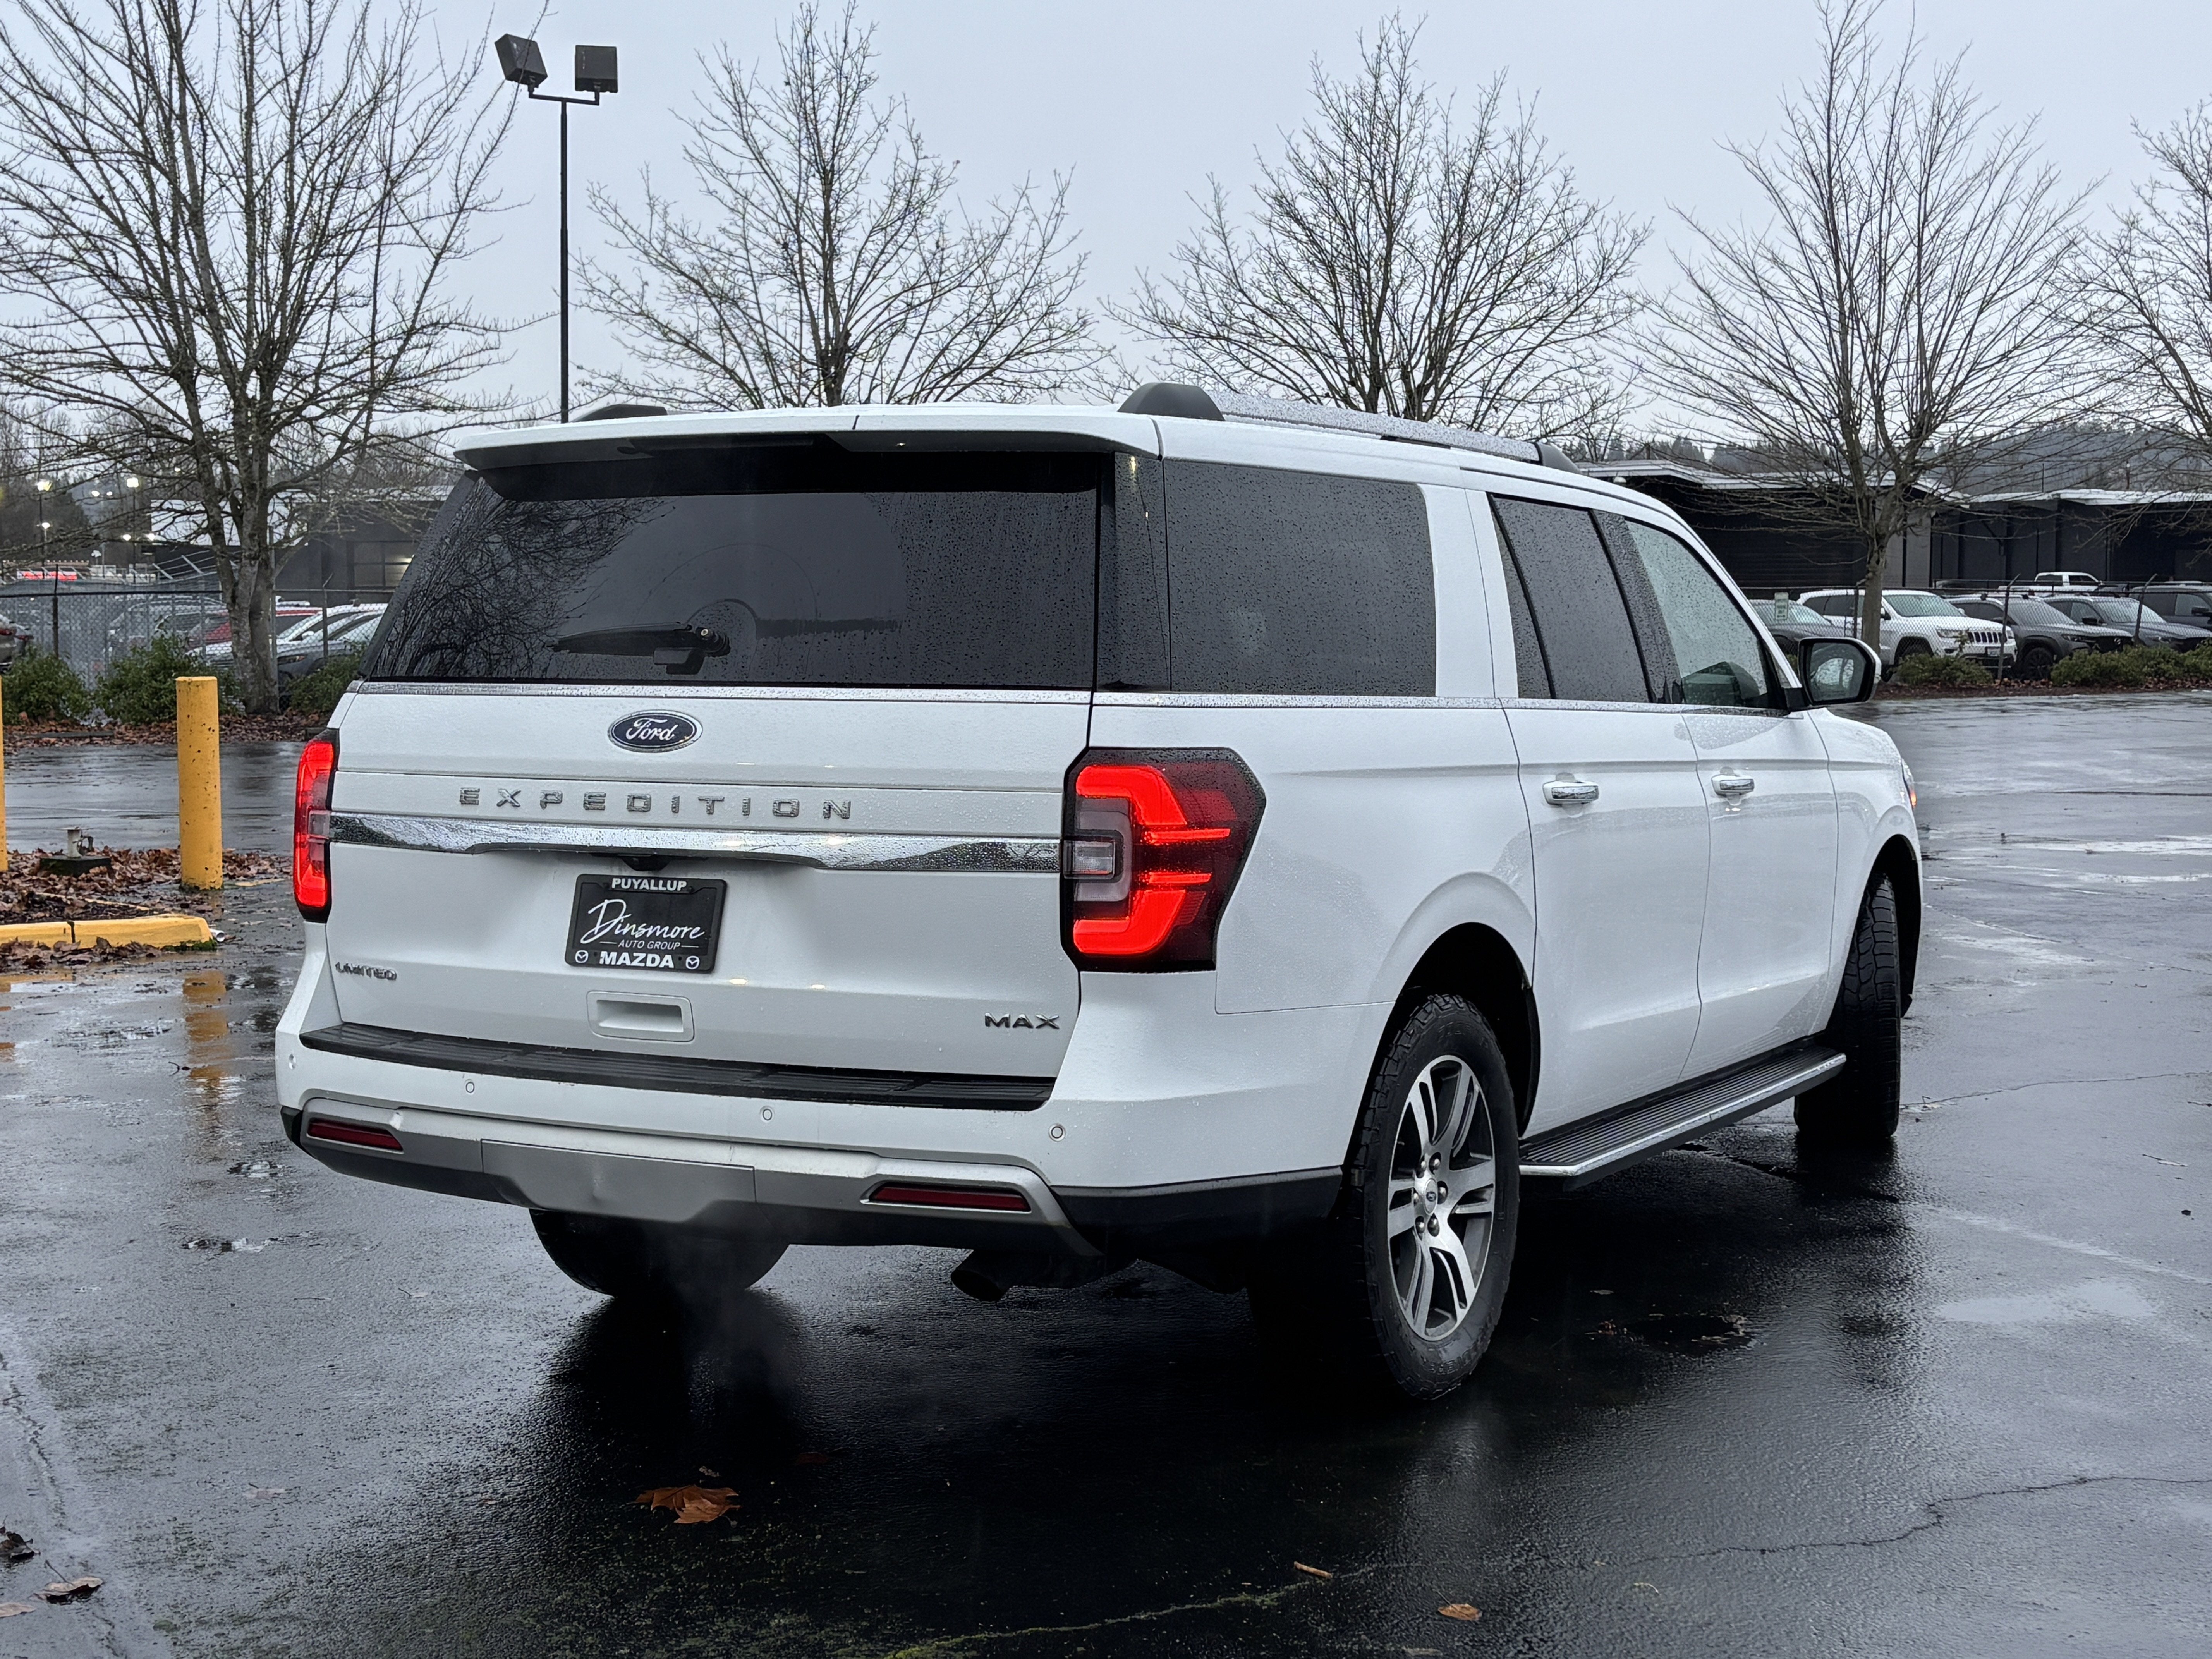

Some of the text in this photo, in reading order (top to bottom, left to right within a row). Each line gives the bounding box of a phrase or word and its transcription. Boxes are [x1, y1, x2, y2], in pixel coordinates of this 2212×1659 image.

[625, 717, 678, 741] Ford
[459, 786, 851, 819] EXPEDITION
[611, 878, 687, 891] PUYALLUP
[580, 899, 705, 944] Dinsmore
[618, 939, 681, 950] AUTO GROUP
[599, 951, 675, 968] MAZDA
[984, 1012, 1060, 1029] MAX
